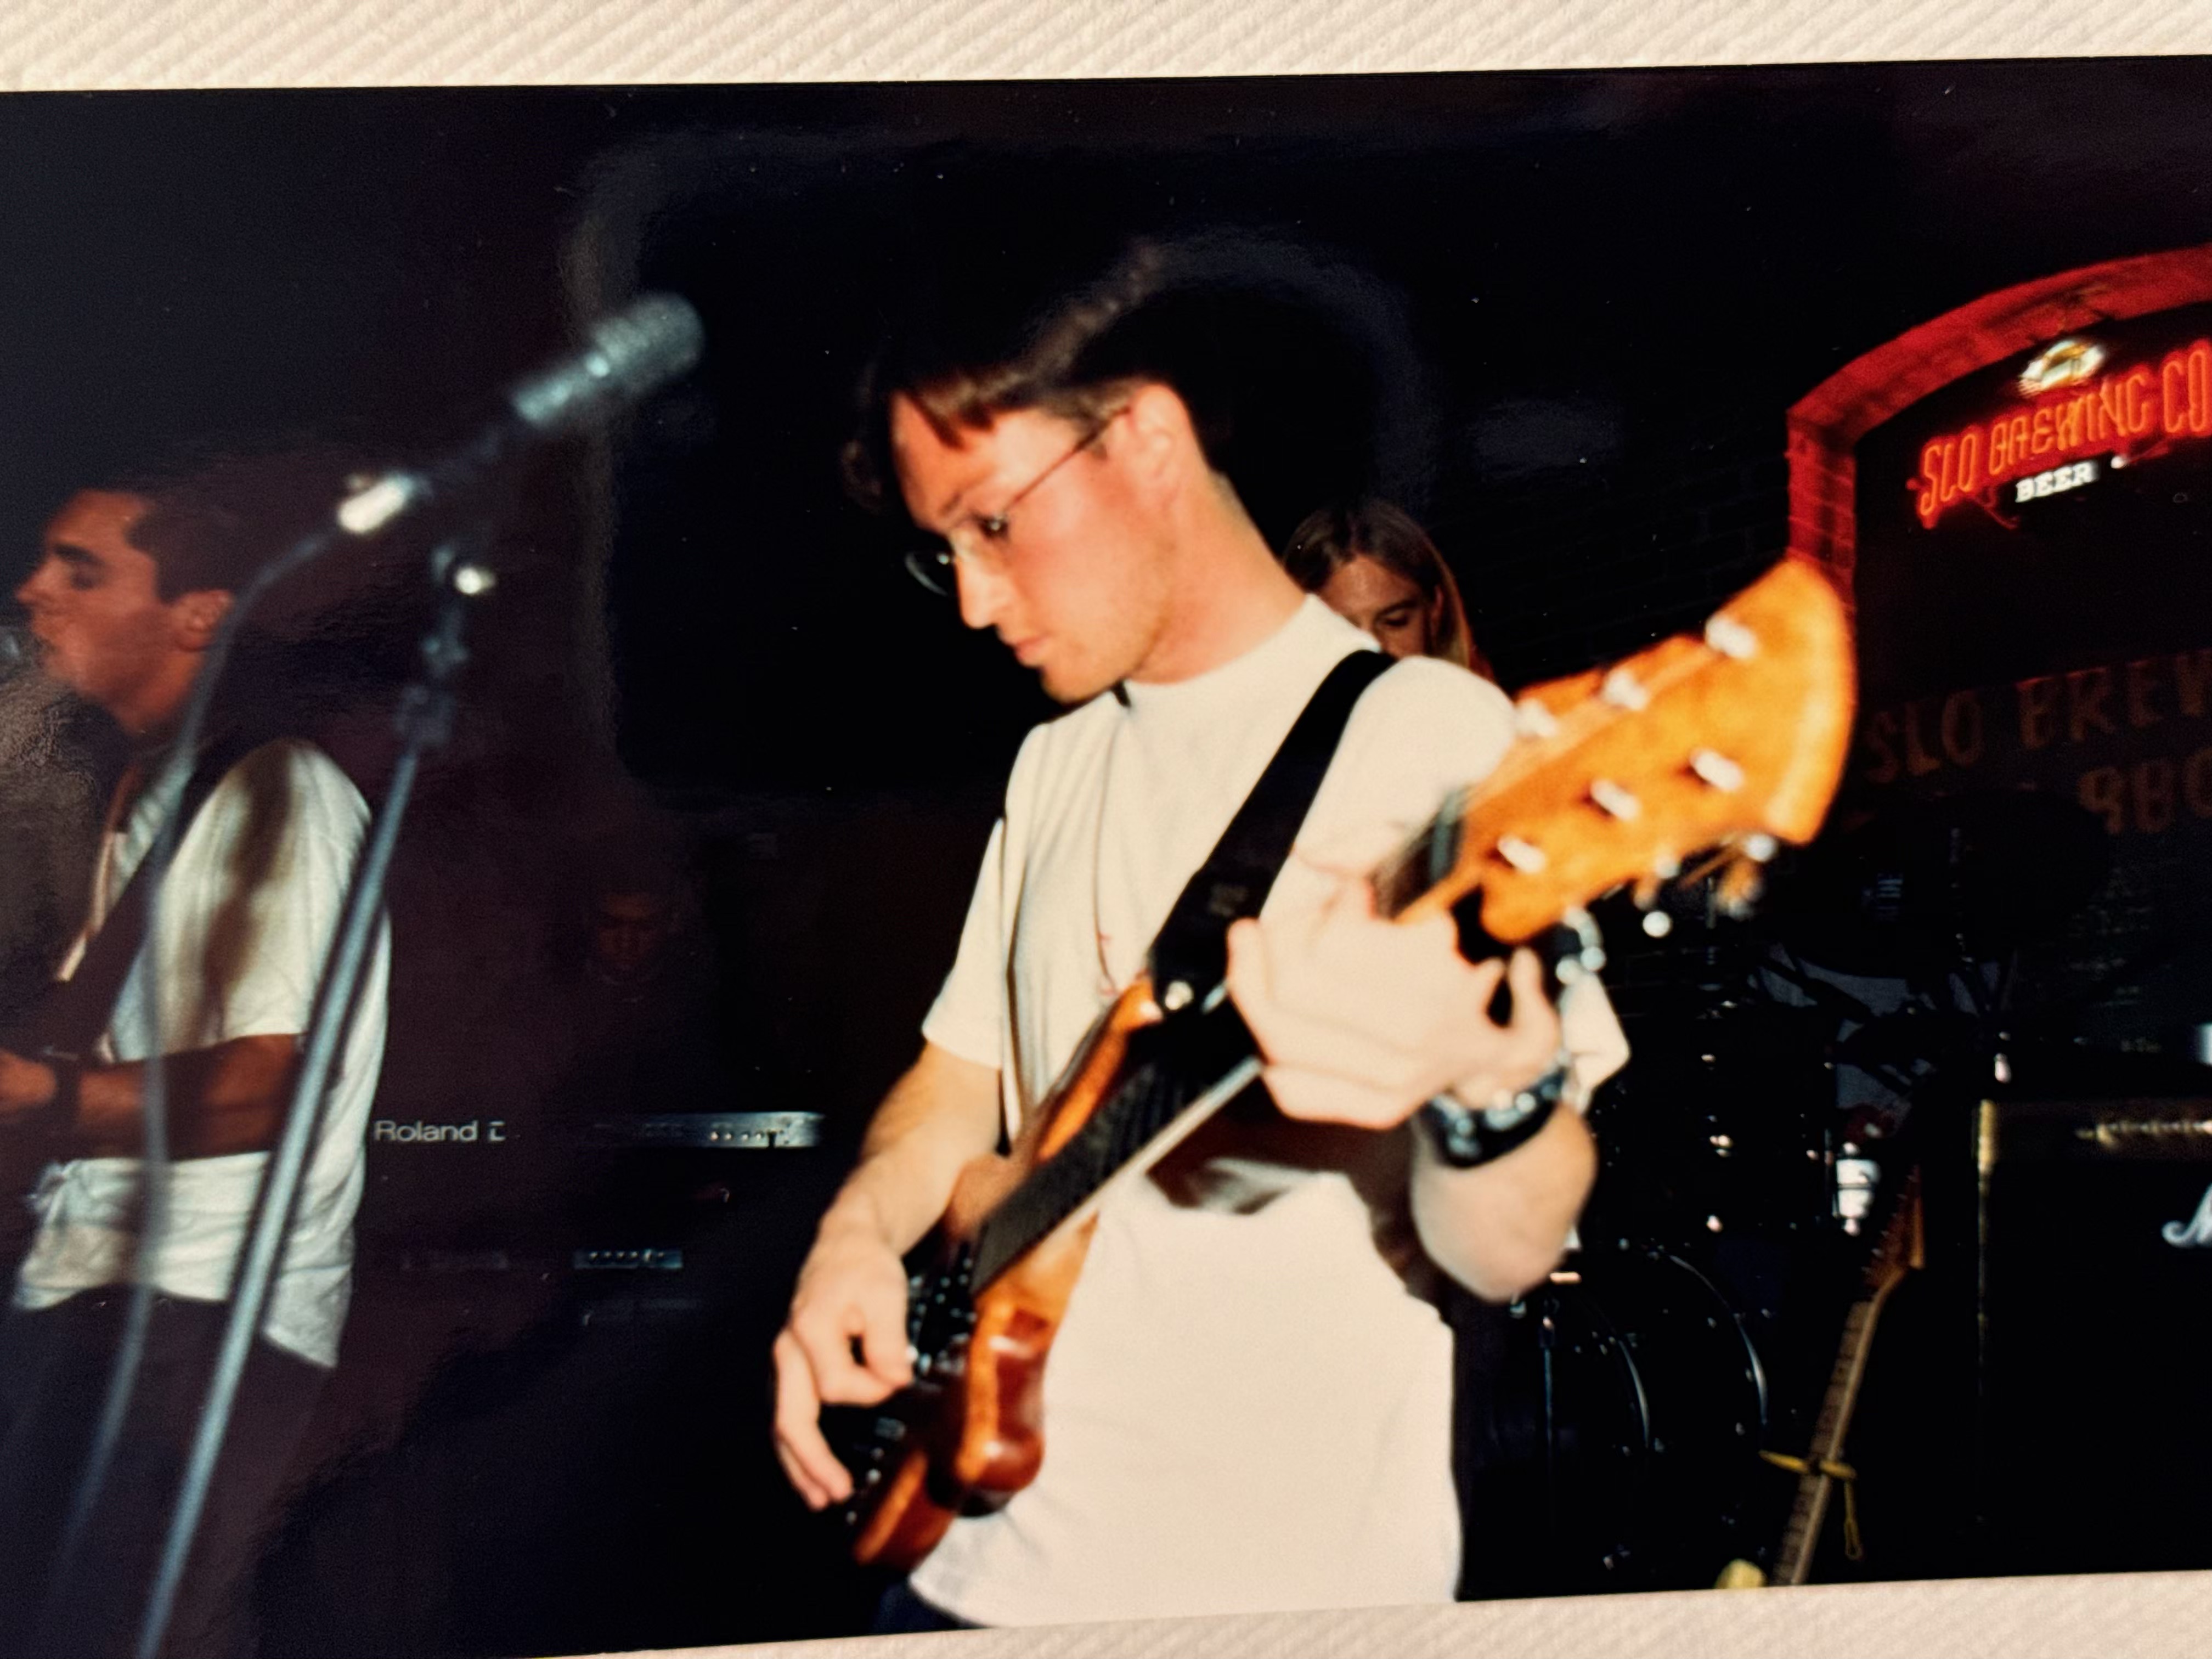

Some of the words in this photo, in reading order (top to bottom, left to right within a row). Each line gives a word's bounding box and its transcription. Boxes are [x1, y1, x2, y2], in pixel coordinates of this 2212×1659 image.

[1919, 431, 1977, 517] SLO
[1988, 374, 2149, 476] BREWING
[2016, 459, 2099, 503] BEER
[1865, 689, 1983, 786] SLO
[374, 1120, 478, 1142] Roland
